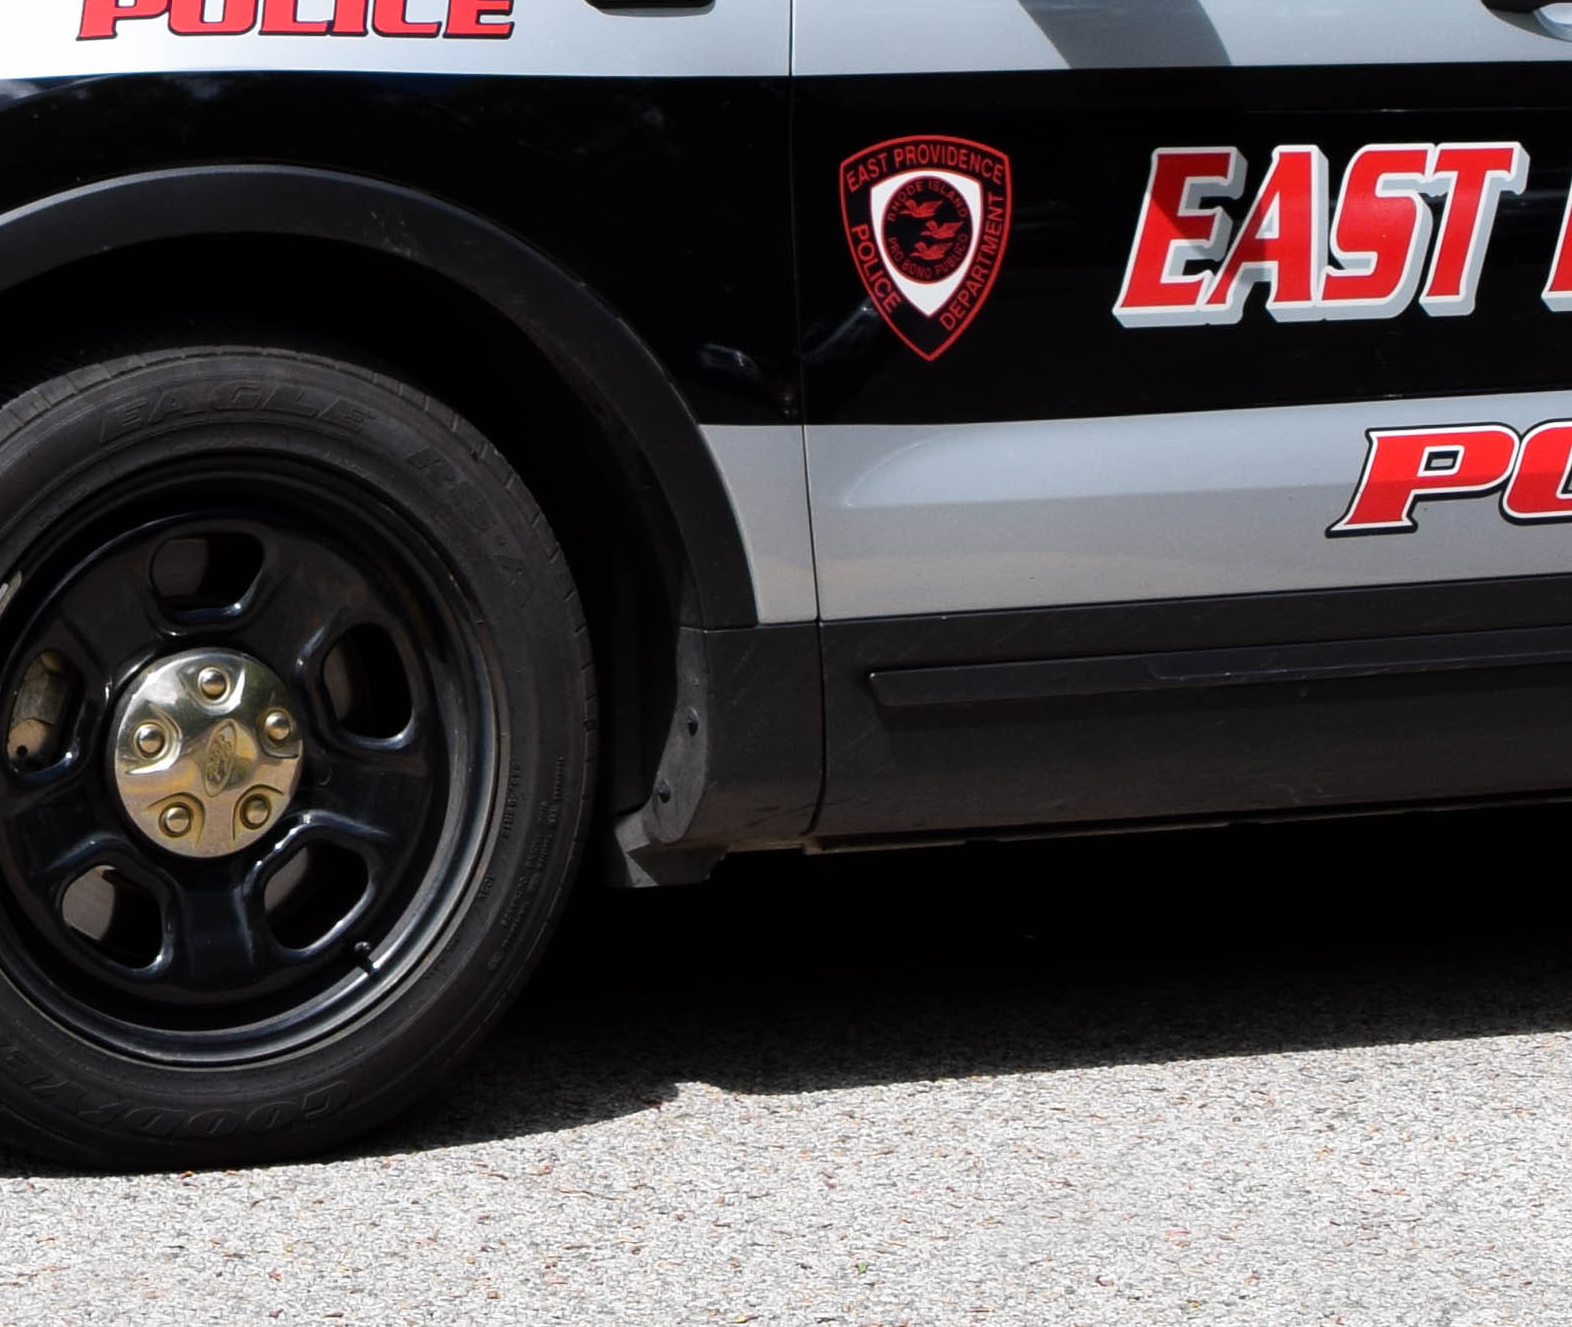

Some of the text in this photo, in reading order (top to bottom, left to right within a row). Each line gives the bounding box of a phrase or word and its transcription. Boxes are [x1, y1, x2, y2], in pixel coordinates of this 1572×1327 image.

[846, 144, 1005, 193] EAST PROVIDENCE
[888, 180, 969, 222] RHODE ISLAND
[851, 223, 904, 314] POLICE
[939, 191, 1005, 332] DEPARTMENT
[1113, 142, 1530, 329] EAST
[99, 381, 378, 445] EAGLE
